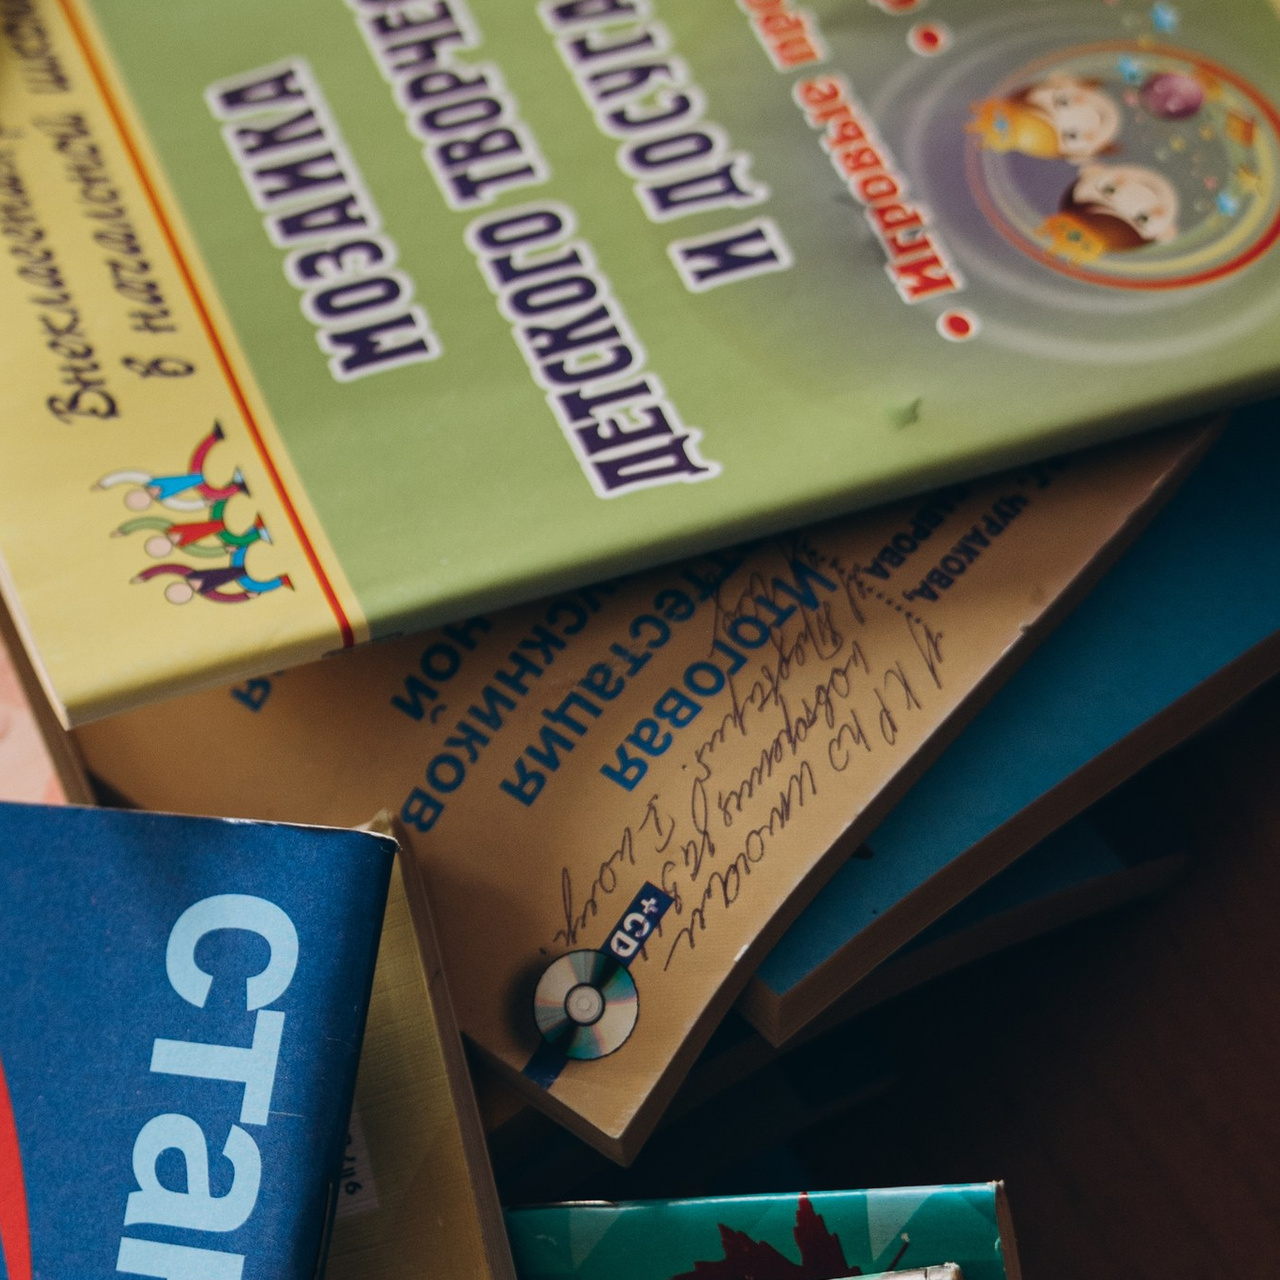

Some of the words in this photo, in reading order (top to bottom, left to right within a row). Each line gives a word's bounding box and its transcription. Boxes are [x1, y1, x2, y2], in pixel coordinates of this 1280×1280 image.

[217, 65, 435, 376] МОЗАИКА
[675, 225, 784, 285] И
[801, 78, 956, 300] Игровые
[120, 353, 198, 381] в
[472, 207, 712, 495] ДЕТСКОГО
[903, 492, 1029, 603] ЧУРАКОВА,
[401, 578, 620, 833] ускников
[499, 542, 758, 808] ттестация
[599, 556, 838, 793] Итоговая
[608, 895, 659, 960] +CD
